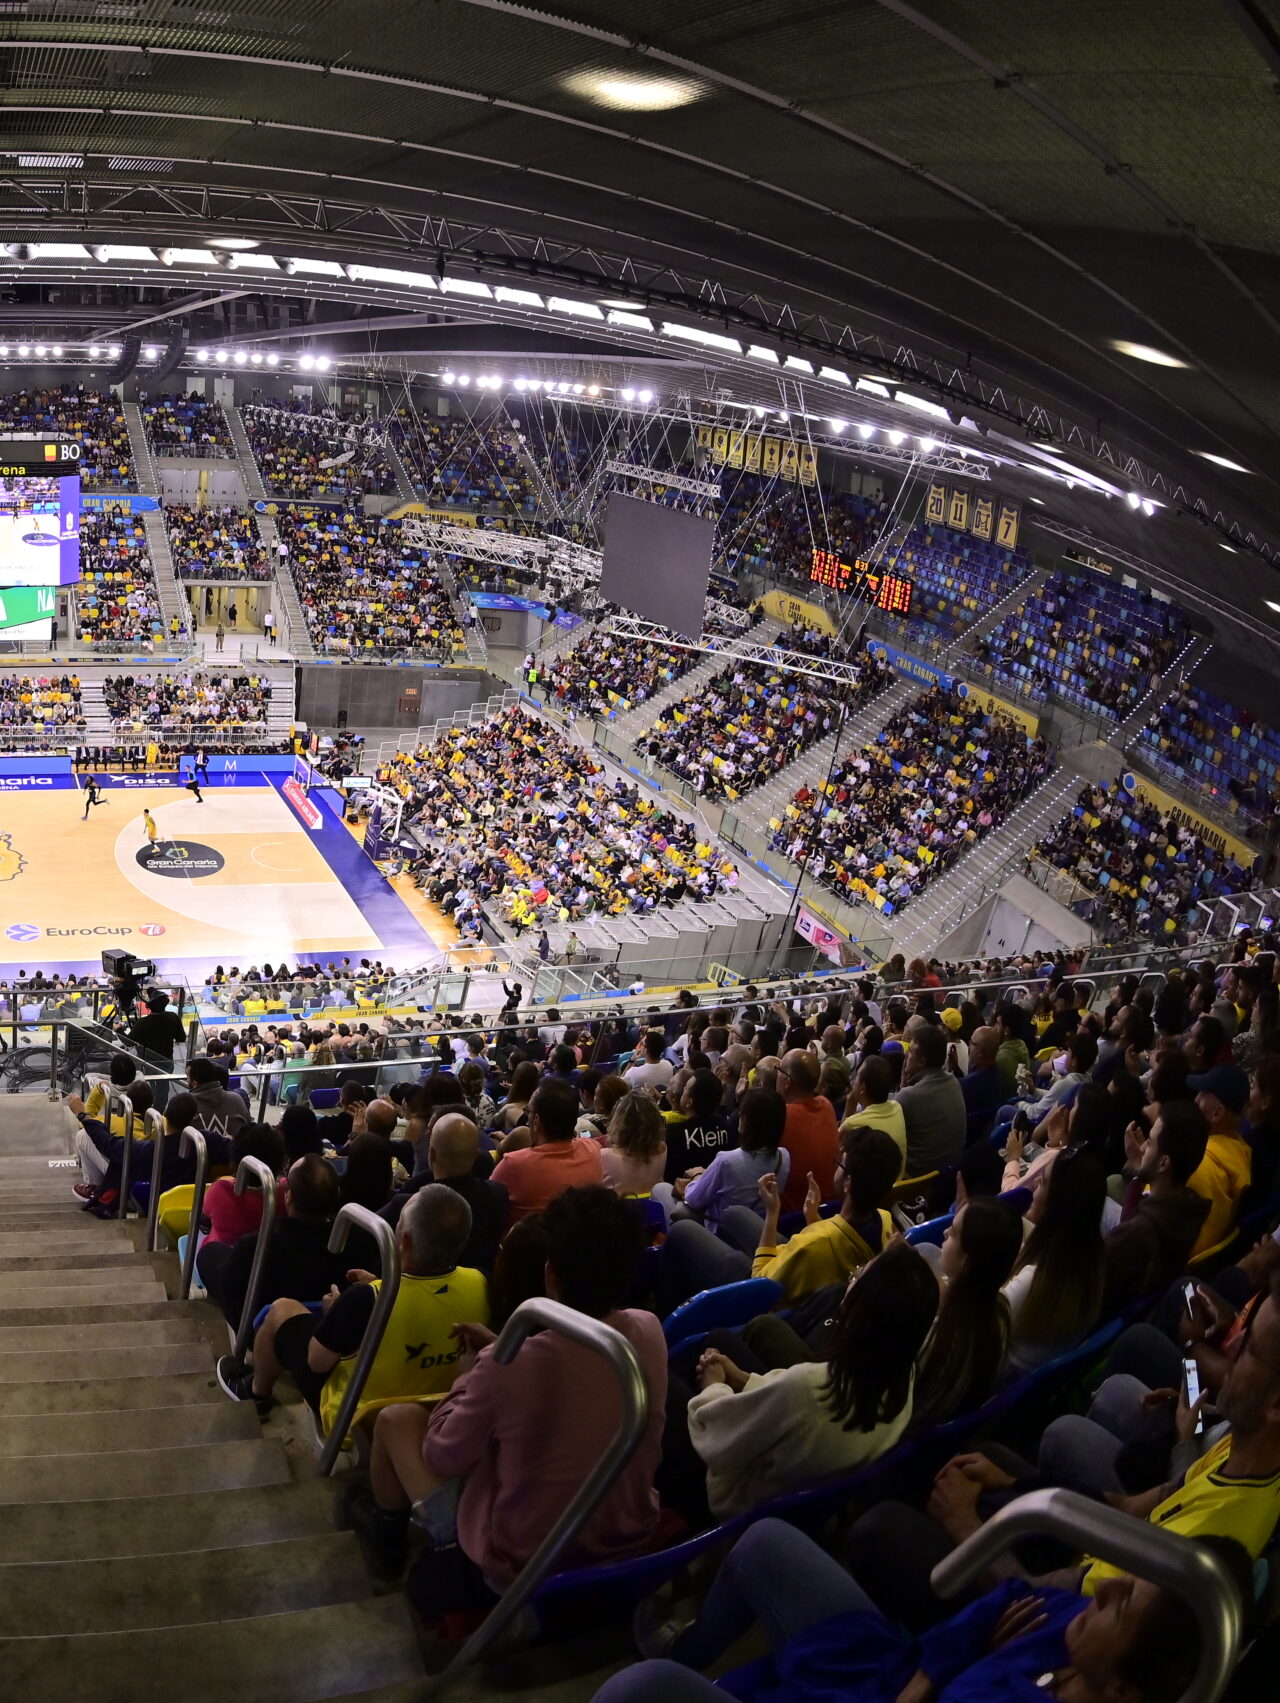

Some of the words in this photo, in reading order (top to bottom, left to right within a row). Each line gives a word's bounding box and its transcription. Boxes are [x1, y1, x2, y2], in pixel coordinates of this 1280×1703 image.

[929, 496, 943, 516] 20
[953, 503, 964, 523] 11
[1004, 520, 1012, 539] 7
[224, 759, 237, 771] M
[174, 858, 217, 866] Canaria
[46, 926, 132, 937] EuroCup
[684, 1126, 729, 1150] Klein
